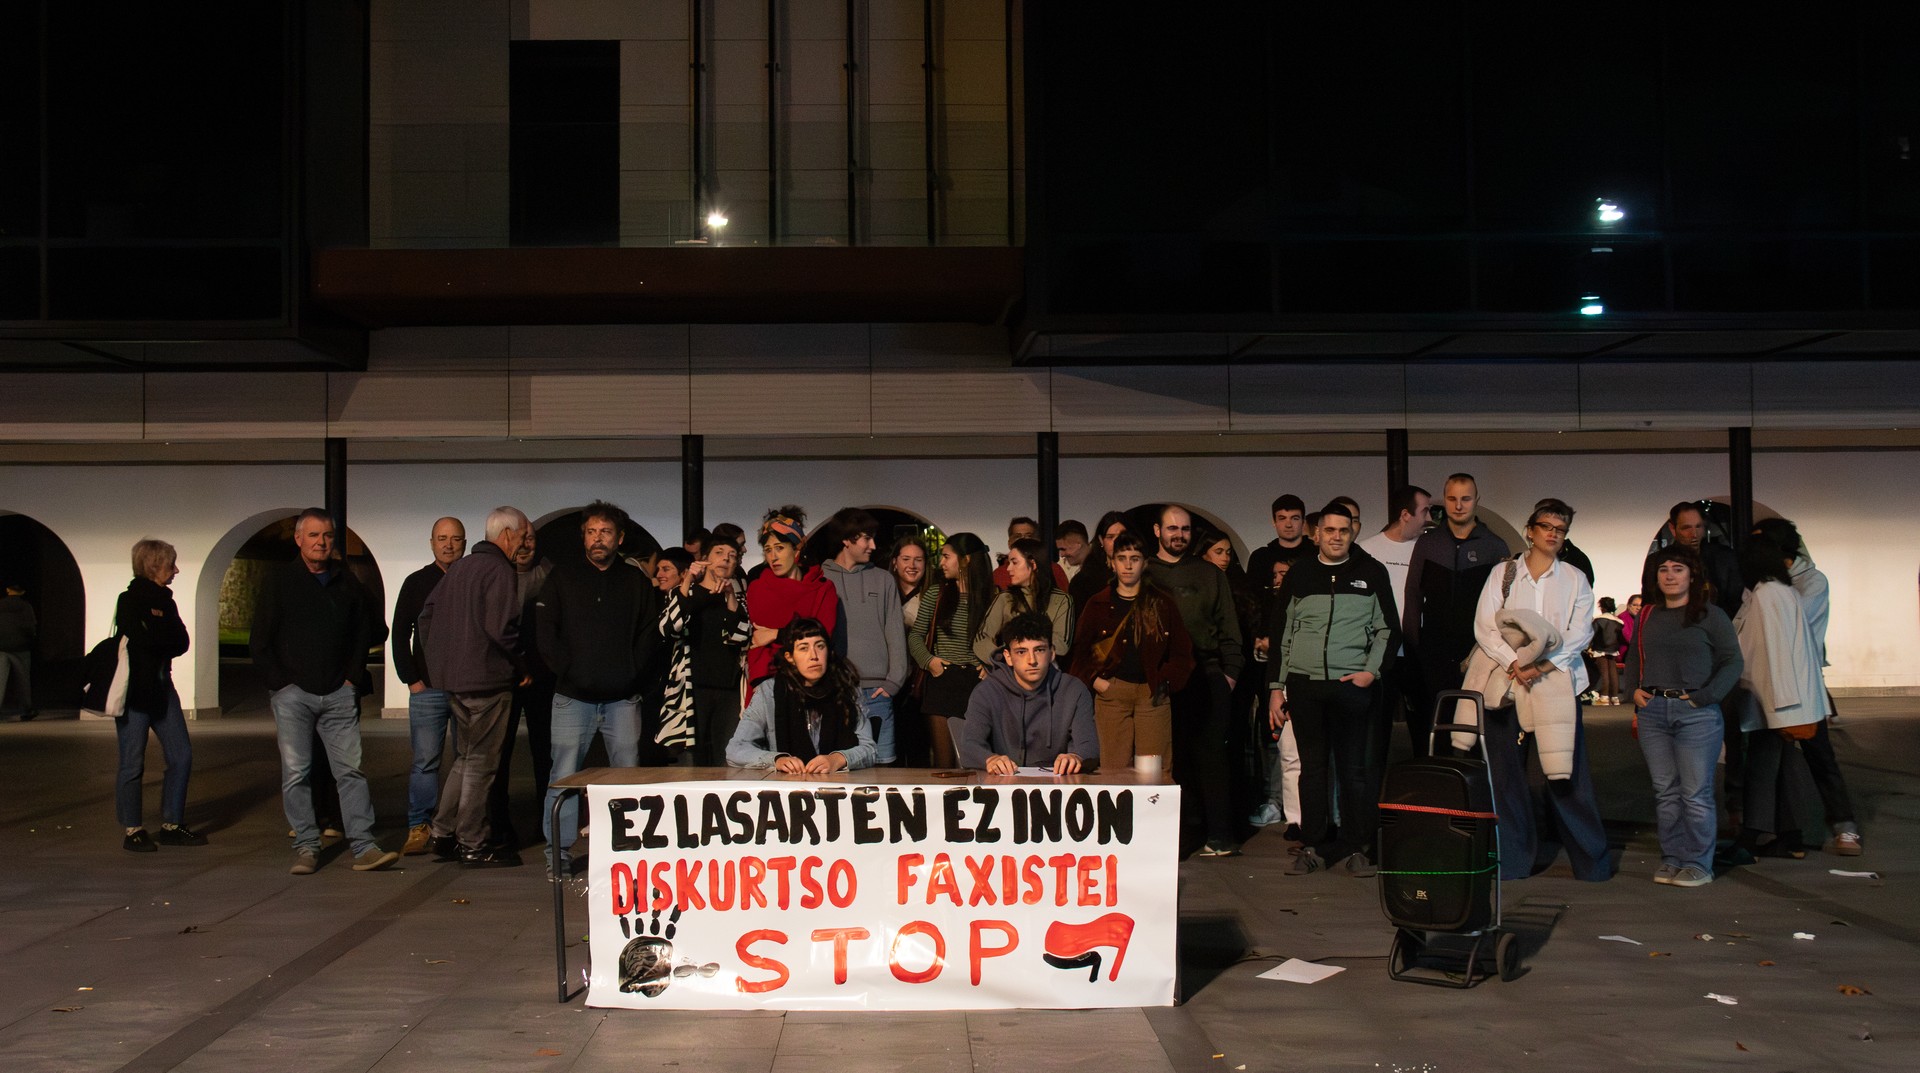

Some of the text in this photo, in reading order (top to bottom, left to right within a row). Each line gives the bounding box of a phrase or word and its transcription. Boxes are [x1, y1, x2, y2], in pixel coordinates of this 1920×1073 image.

[608, 786, 1134, 851] EZ LASARTEN EZ INON
[611, 852, 1118, 915] DISKURTSO FAXISTEI
[735, 920, 1020, 993] STOP
